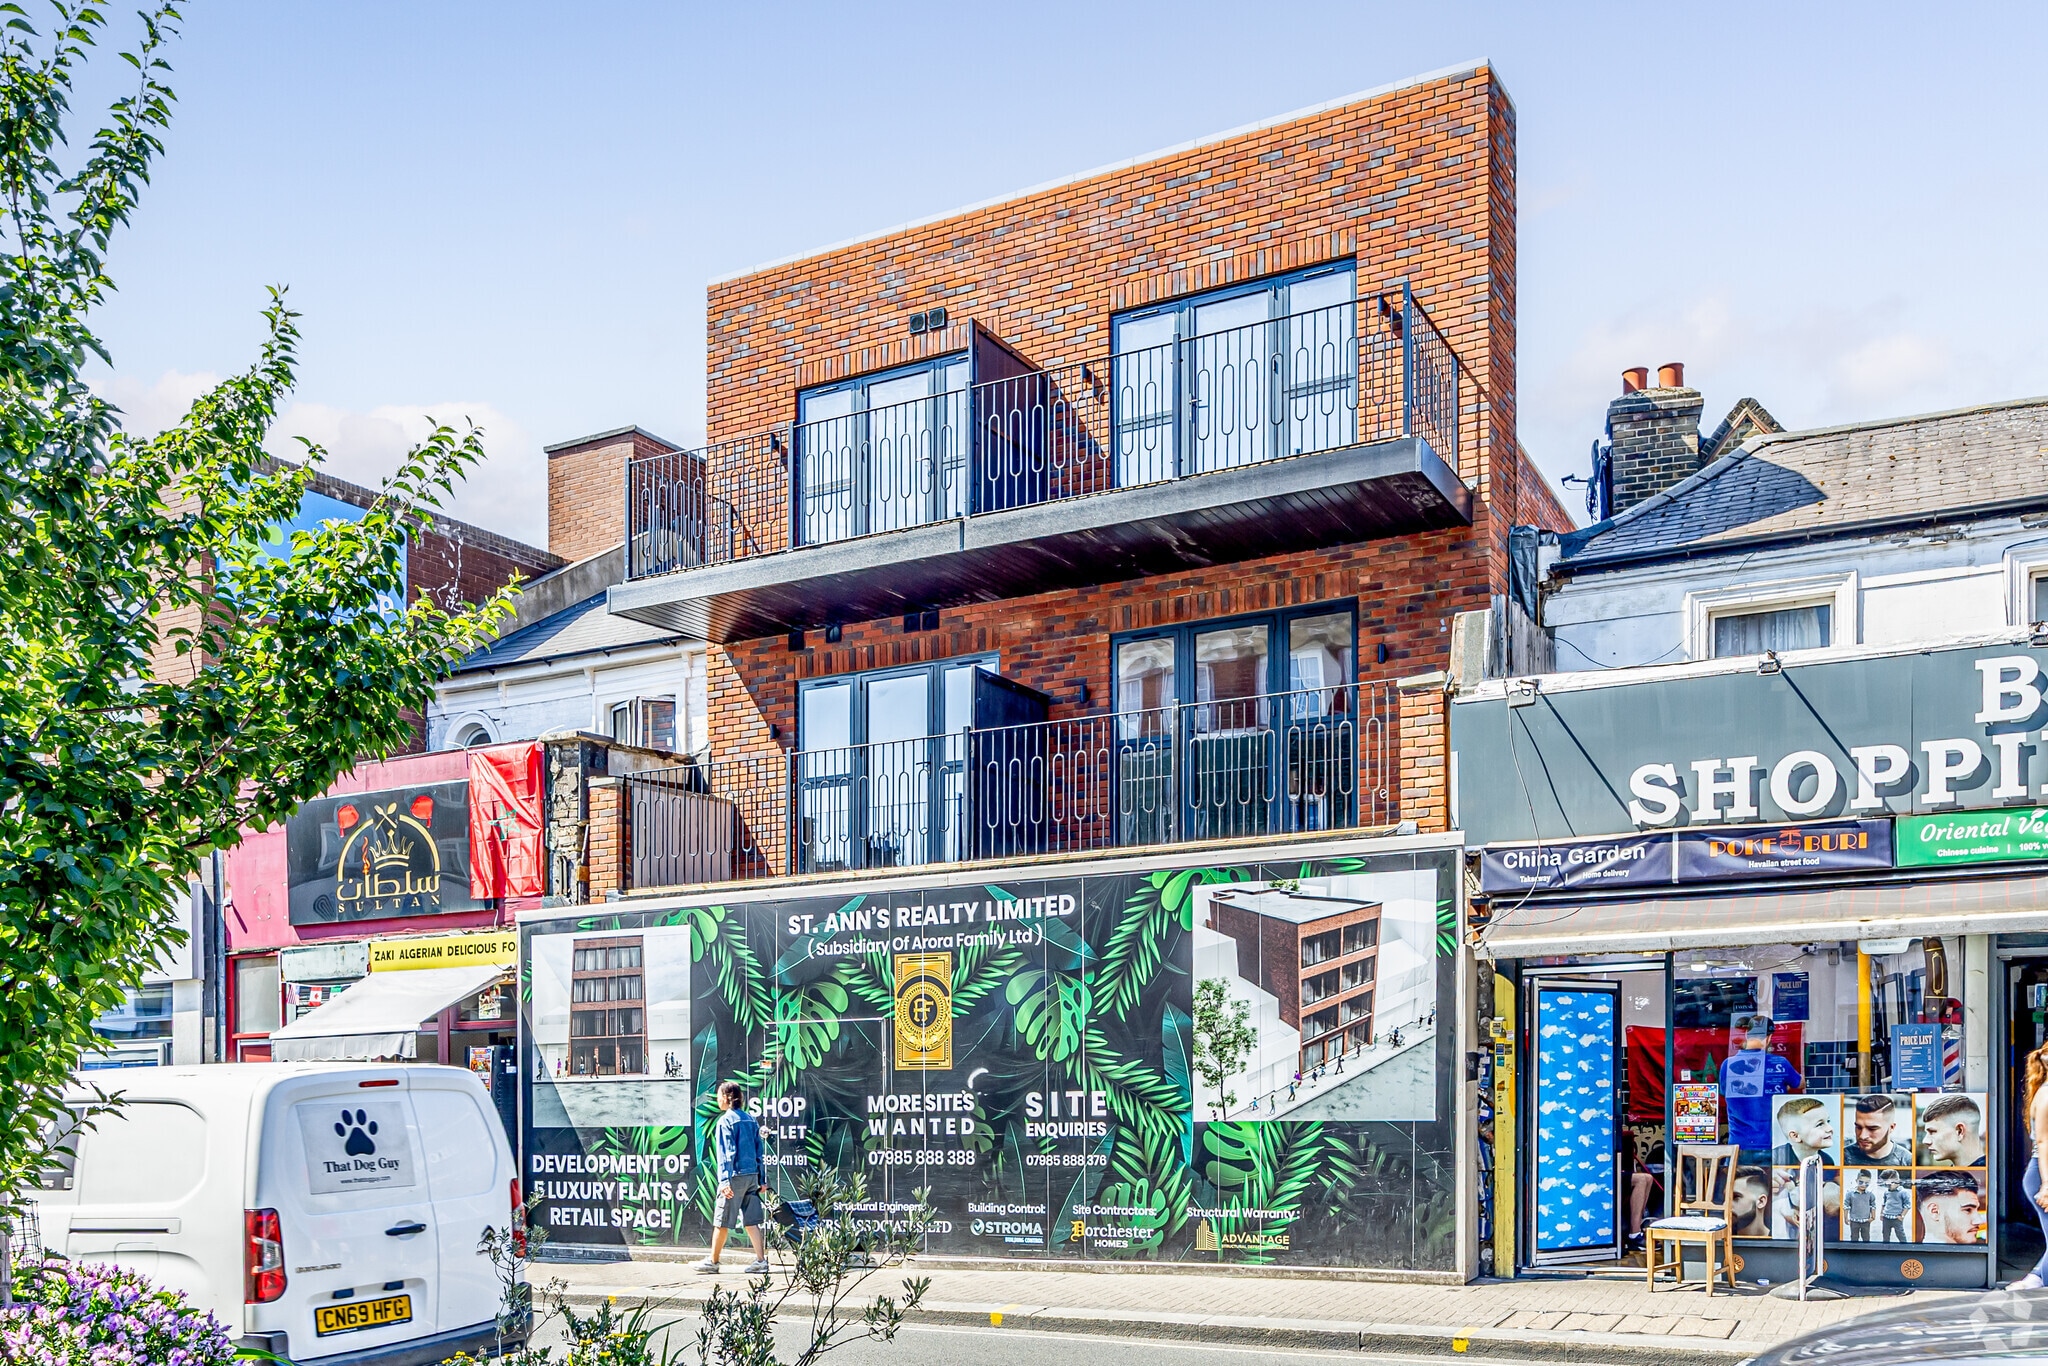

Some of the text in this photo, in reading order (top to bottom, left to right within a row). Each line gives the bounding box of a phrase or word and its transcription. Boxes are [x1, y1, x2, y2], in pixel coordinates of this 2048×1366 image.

[1629, 730, 2048, 826] SHOPPI
[1920, 816, 2011, 843] Oriental
[1709, 832, 1869, 858] POKE BURI
[1937, 848, 1969, 857] Chinese
[1970, 846, 1999, 855] cuisine
[2019, 842, 2040, 851] 100%
[1503, 845, 1645, 869] China Garden
[1780, 859, 1801, 867] street
[1802, 857, 1820, 865] food
[1582, 869, 1629, 879] Home delivery
[336, 870, 440, 901] سلطان
[338, 894, 440, 913] SULTAN
[788, 914, 819, 935] ST.
[897, 901, 980, 928] REALTY
[986, 894, 1076, 921] LIMITED
[892, 936, 909, 952] Of
[914, 933, 953, 951] Arora
[956, 928, 1007, 950] Family
[374, 949, 395, 962] ZAKI
[399, 946, 443, 960] ALGERIAN
[447, 942, 497, 957] DELICIOUS
[1900, 1035, 1933, 1046] PRICE LIST
[749, 1097, 807, 1118] SHOP
[867, 1094, 922, 1113] MORE
[1025, 1090, 1107, 1118] SITE
[868, 1117, 975, 1136] WANTED
[1025, 1121, 1107, 1139] ENQUIRIES
[323, 1157, 400, 1173] That Dog Guy
[532, 1154, 690, 1174] DEVELOPMENT OF
[780, 1154, 793, 1166] 411
[794, 1154, 808, 1166] 191
[868, 1149, 976, 1166] 07985 888 388
[1026, 1154, 1107, 1167] 07985 888 376
[548, 1181, 616, 1200] LUXURY
[618, 1182, 673, 1200] FLATS
[675, 1181, 690, 1201] &
[833, 1201, 878, 1211] Structural
[968, 1203, 1006, 1215] Building
[1072, 1204, 1091, 1215] Site
[1186, 1207, 1240, 1218] Structural
[550, 1207, 672, 1228] RETAIL SPACE
[985, 1221, 1043, 1235] STROMA
[1070, 1220, 1155, 1242] Dorchester
[1094, 1240, 1129, 1248] HOMES
[1221, 1231, 1290, 1245] ADVANTAGE
[323, 1299, 405, 1329] CN69 HFG
